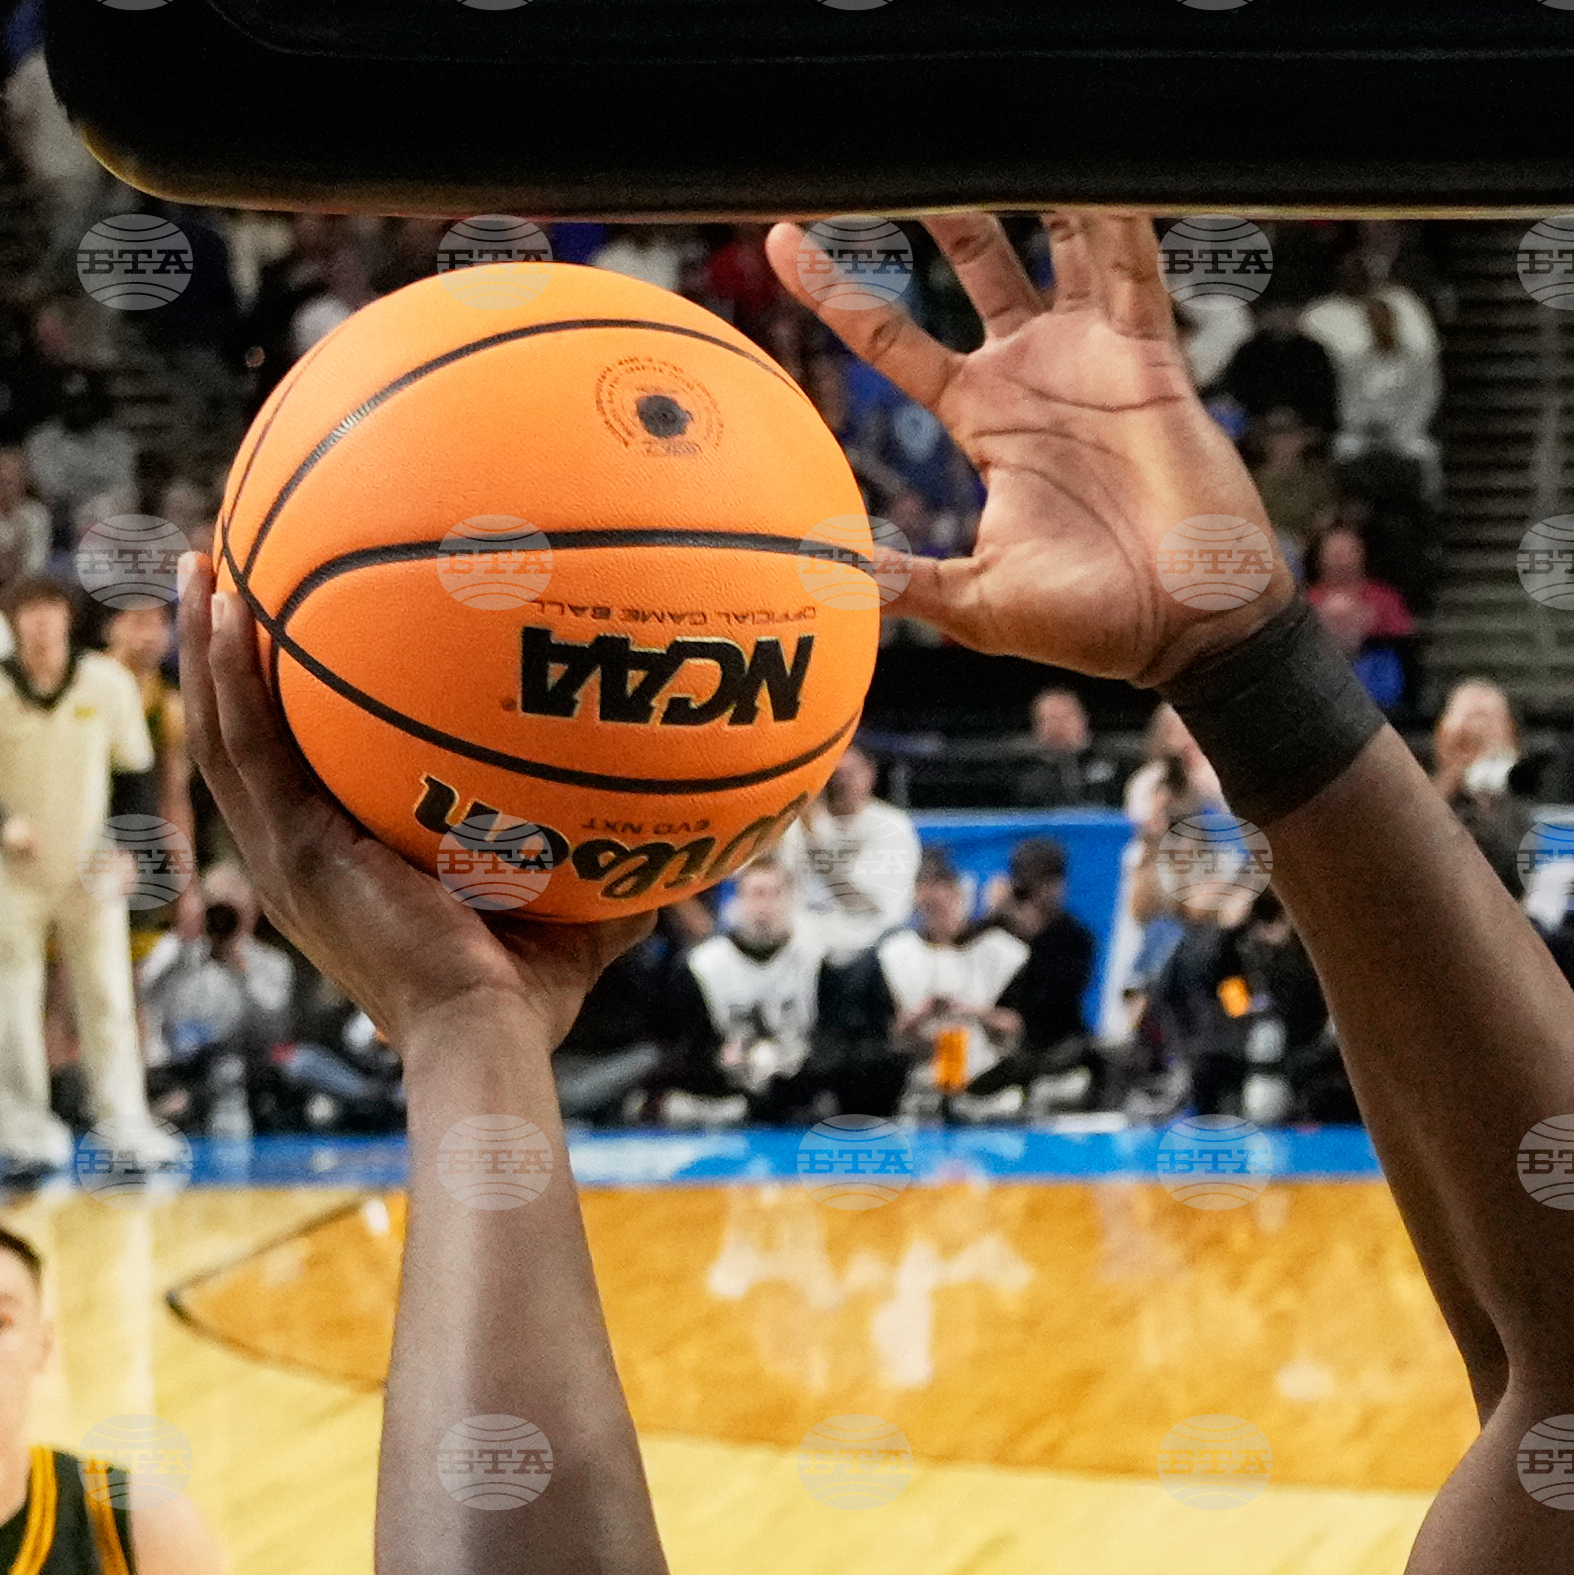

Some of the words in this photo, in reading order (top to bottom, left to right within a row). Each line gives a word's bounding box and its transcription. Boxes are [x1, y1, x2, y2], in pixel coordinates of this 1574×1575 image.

[530, 600, 613, 622] BALL
[619, 605, 708, 626] GAME
[719, 604, 817, 626] OFFICIAL
[520, 626, 816, 728] NCAA
[581, 818, 646, 836] NXT
[654, 818, 712, 836] EVO
